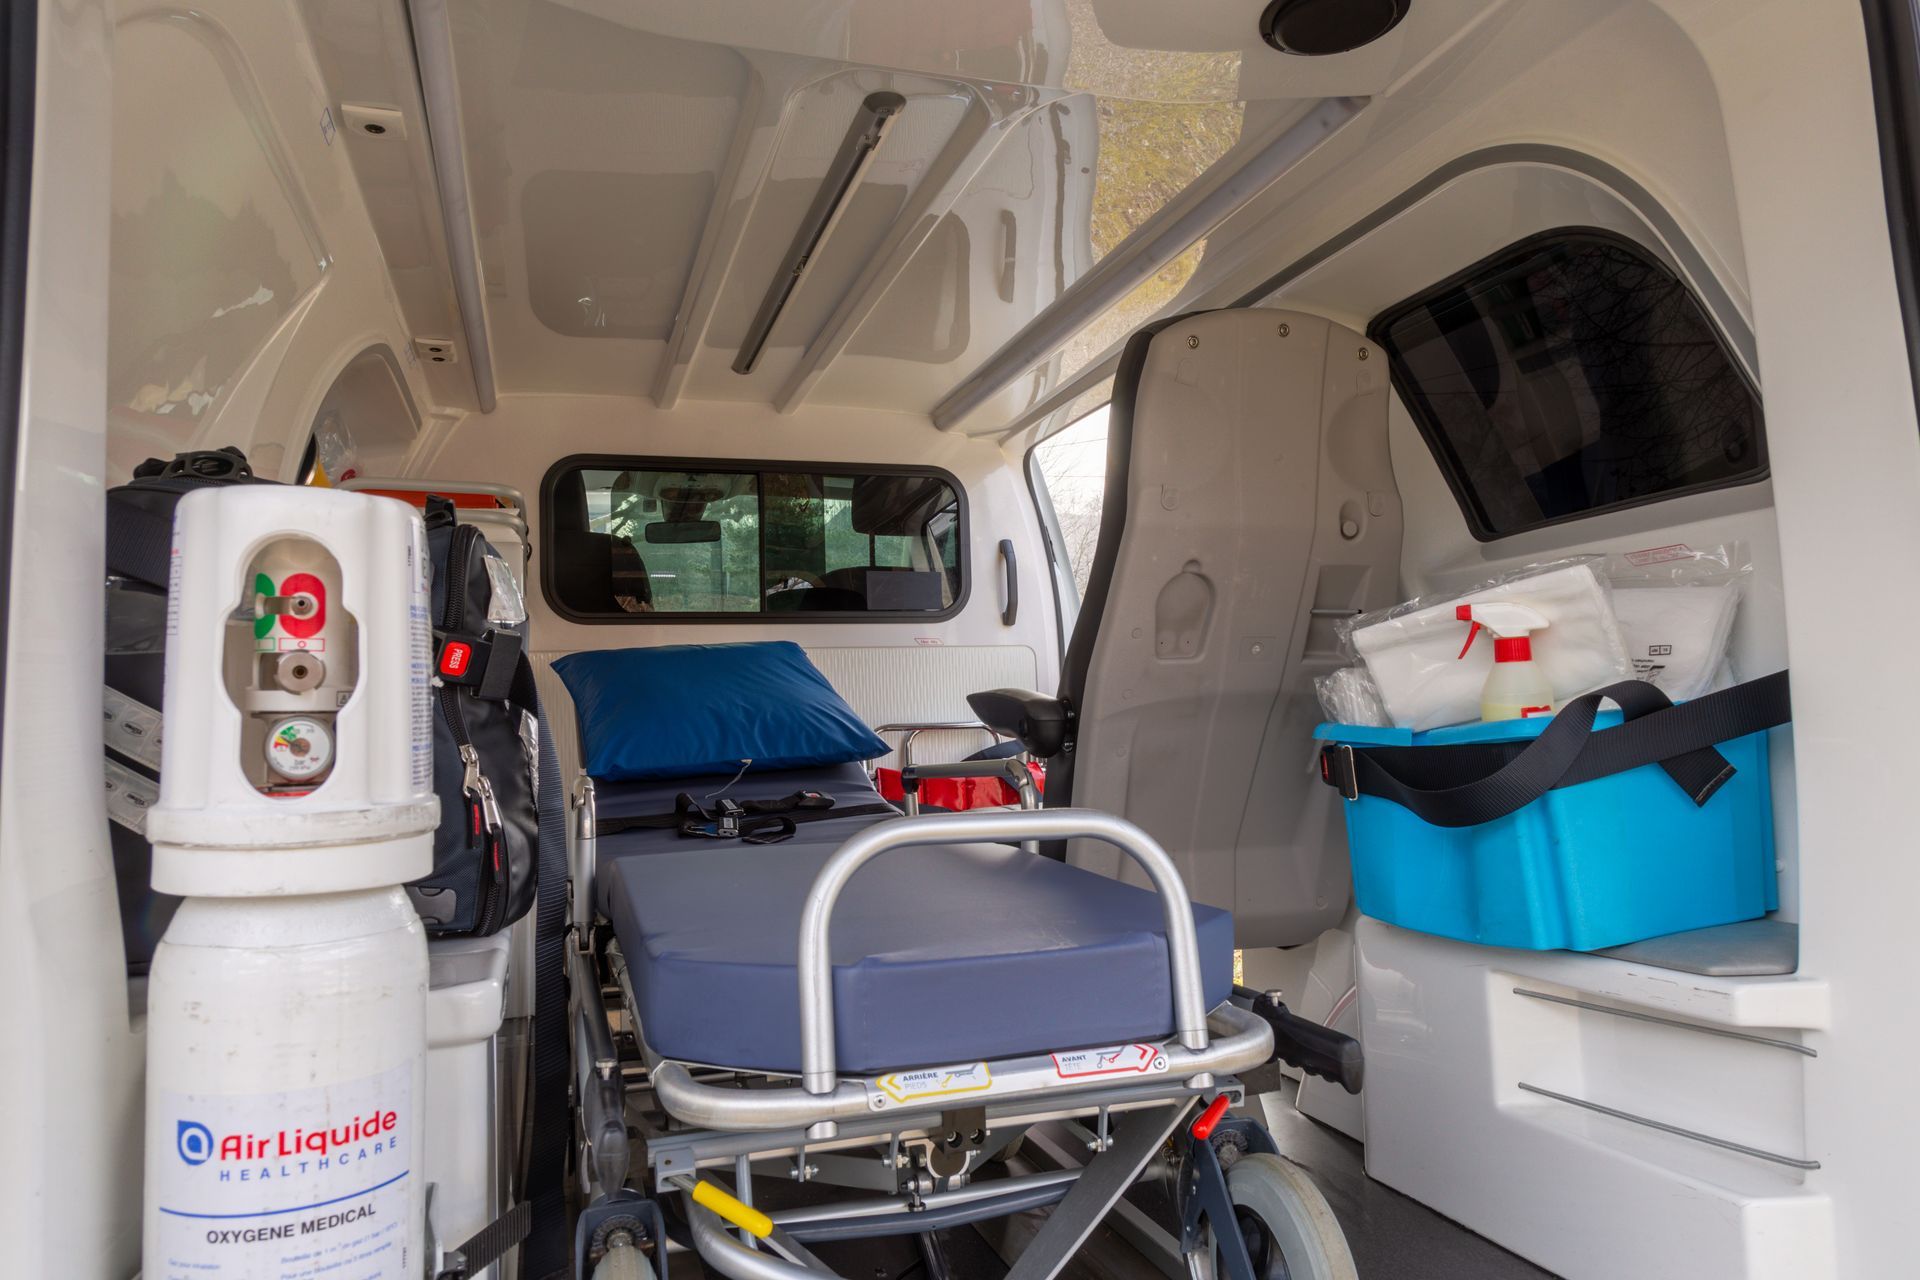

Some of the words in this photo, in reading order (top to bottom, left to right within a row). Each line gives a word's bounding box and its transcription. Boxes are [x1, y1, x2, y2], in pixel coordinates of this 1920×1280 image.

[449, 648, 464, 669] PRESS
[1062, 1054, 1087, 1063] AVANT
[903, 1072, 939, 1082] ARRIÈRE
[904, 1082, 928, 1090] PIEDS
[220, 1134, 271, 1161] Air
[278, 1110, 398, 1156] Liquide
[219, 1136, 397, 1182] HEALTHCARE
[206, 1223, 295, 1244] OXYGENE
[301, 1203, 377, 1235] MEDICAL
